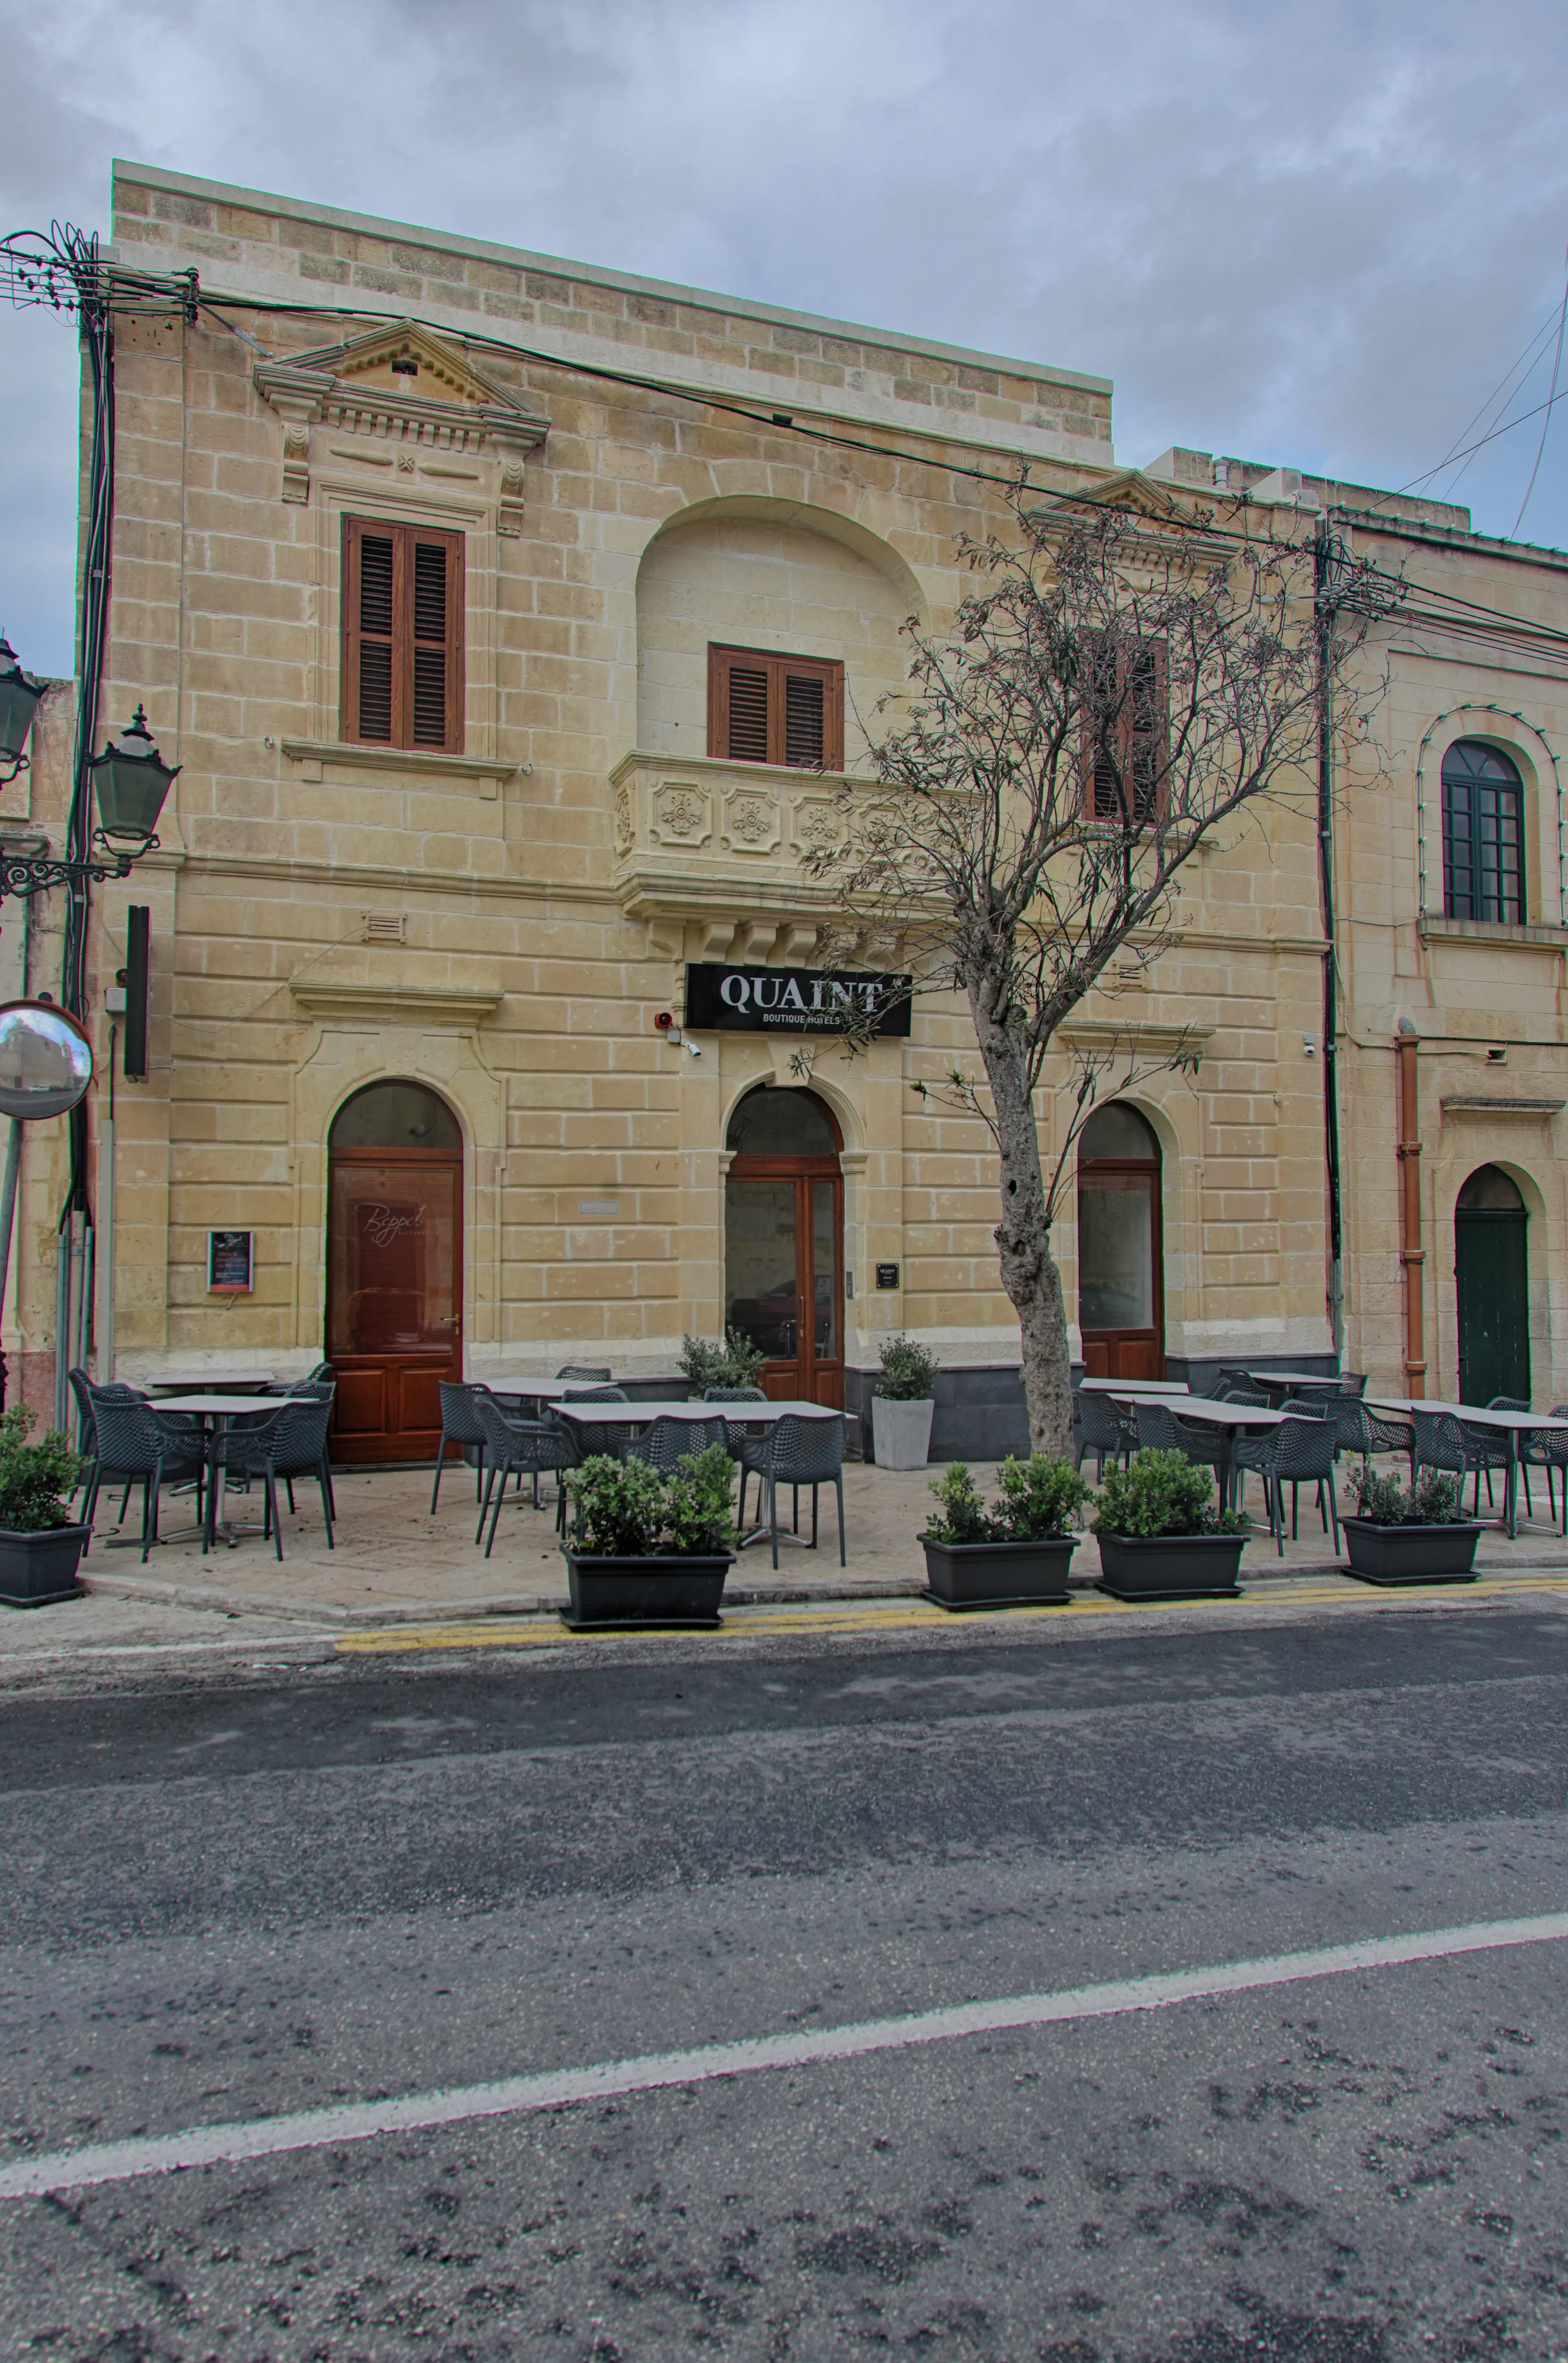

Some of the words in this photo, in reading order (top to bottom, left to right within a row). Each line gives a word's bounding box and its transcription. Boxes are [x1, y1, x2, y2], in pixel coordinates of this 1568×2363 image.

[720, 974, 883, 1013] QUAINT
[763, 1014, 806, 1024] BOUTIQUE
[355, 1203, 427, 1247] Beppe's
